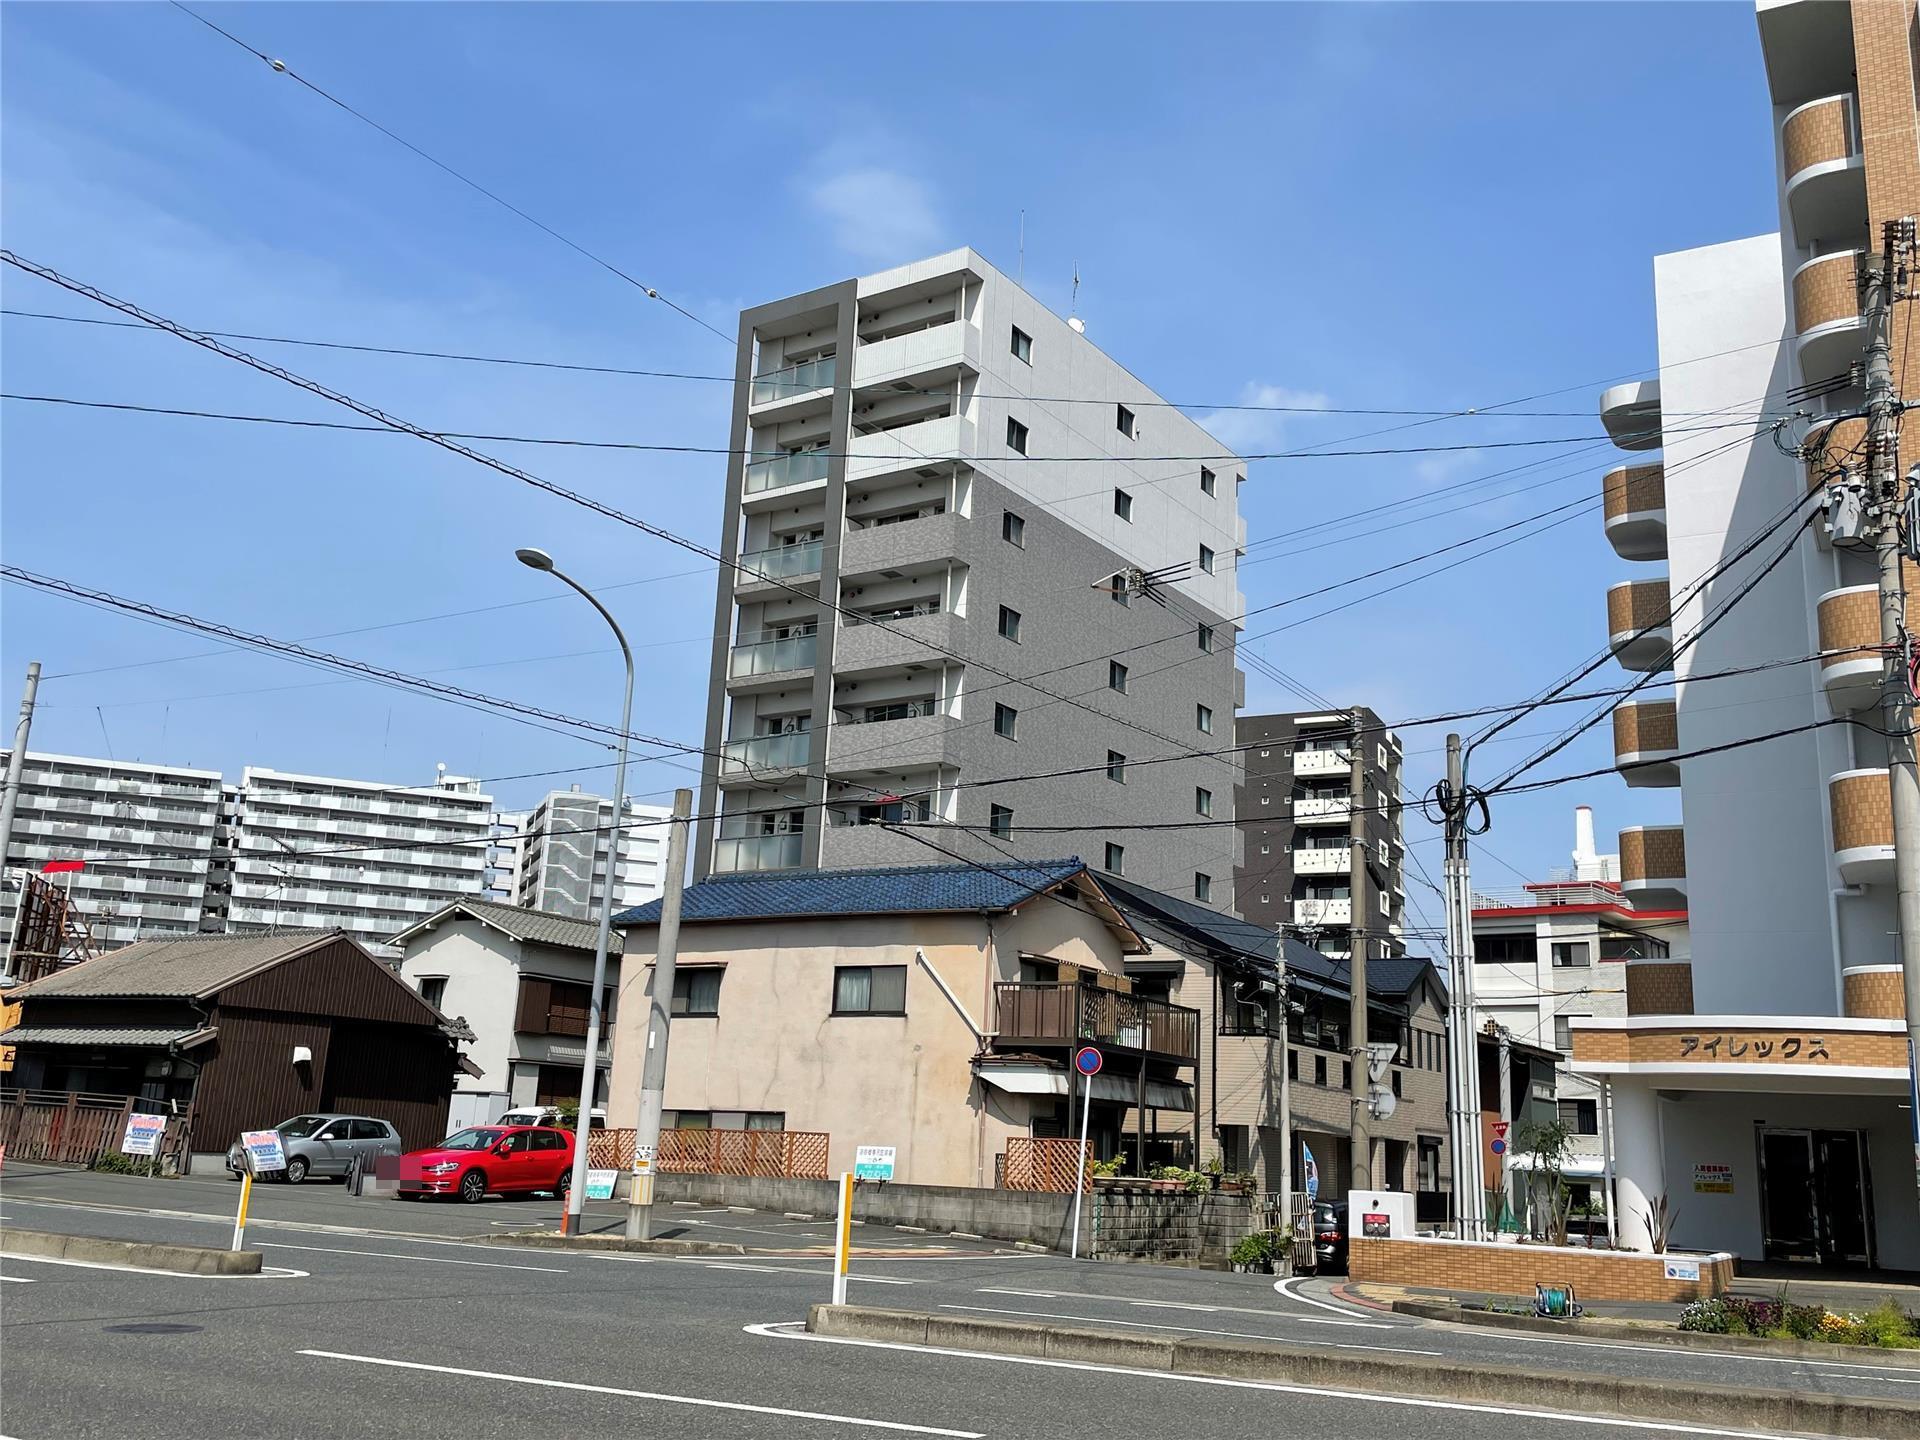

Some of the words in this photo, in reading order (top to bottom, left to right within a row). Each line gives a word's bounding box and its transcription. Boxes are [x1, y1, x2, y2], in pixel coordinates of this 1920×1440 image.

[1680, 1035, 1830, 1060] アイレックス
